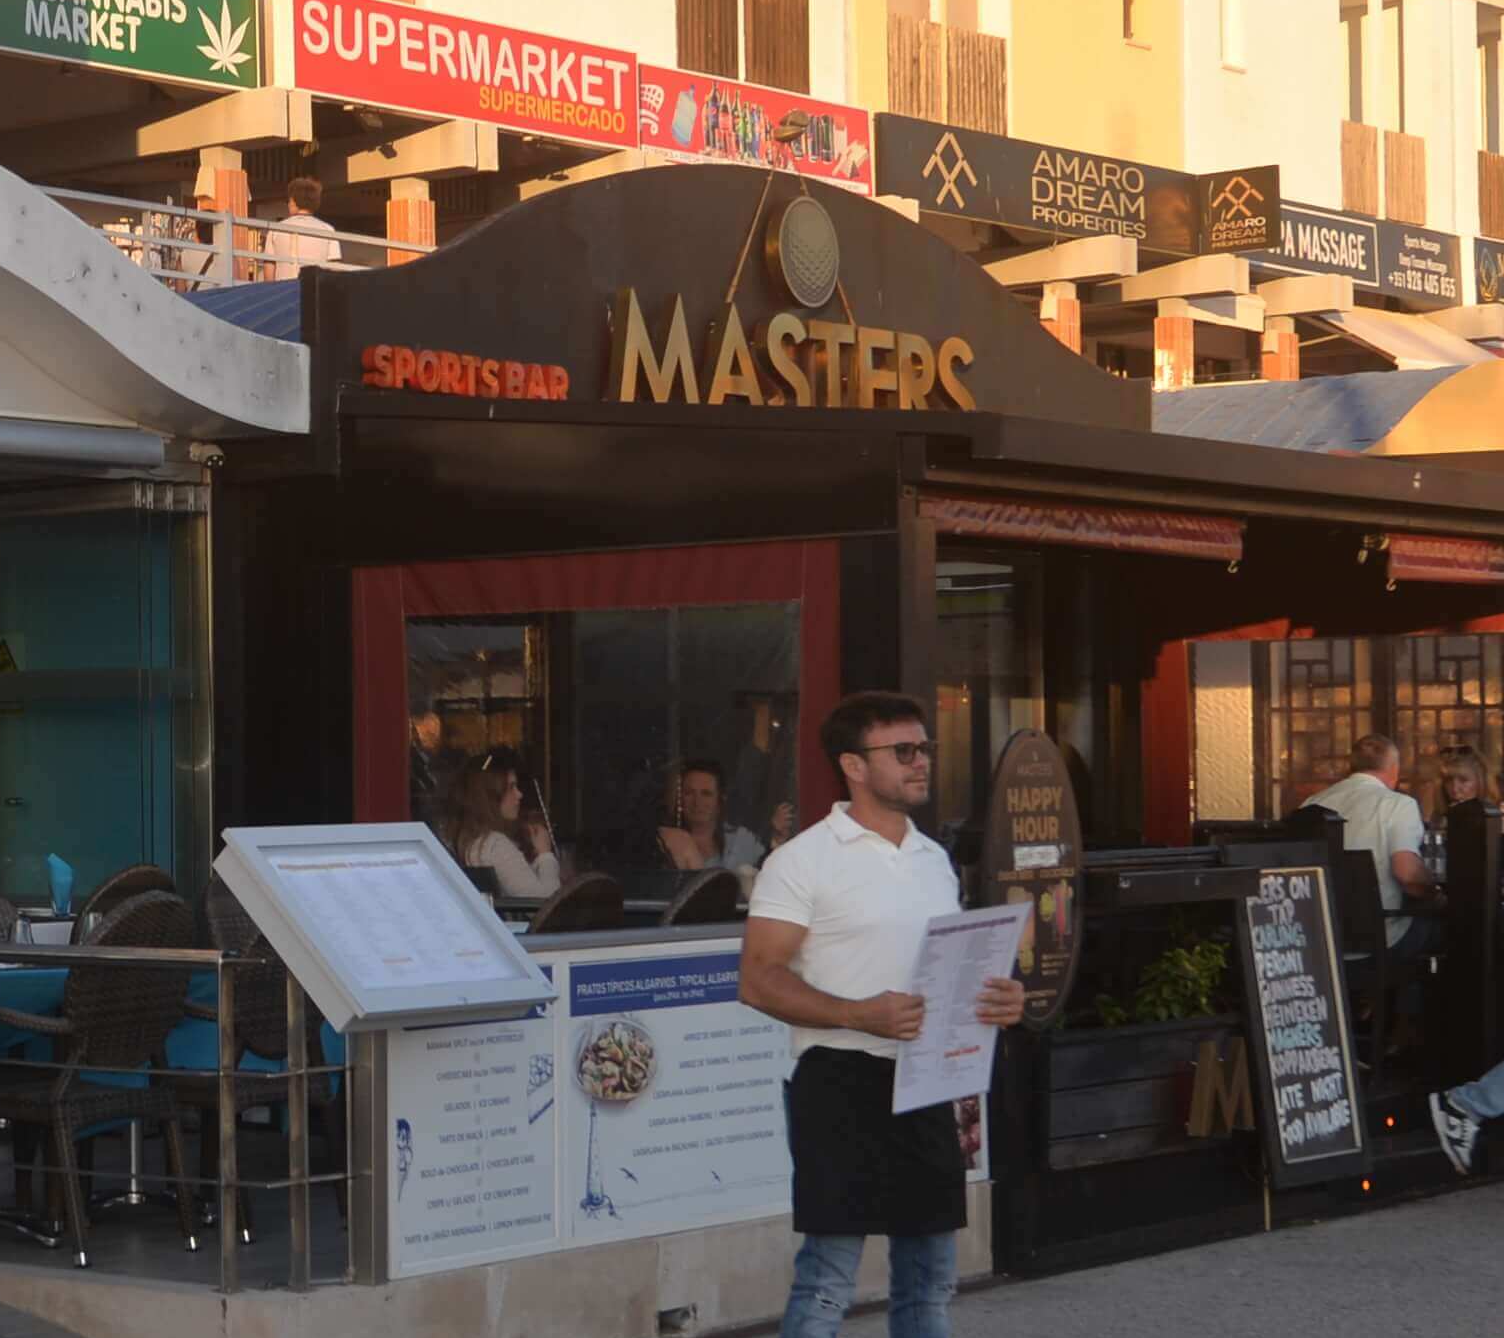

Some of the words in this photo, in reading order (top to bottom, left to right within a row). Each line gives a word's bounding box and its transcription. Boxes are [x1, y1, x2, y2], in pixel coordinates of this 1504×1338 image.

[302, 0, 629, 109] SUPERMARKET
[478, 85, 626, 135] SUPERMERCADO
[1032, 150, 1144, 194] AMARO
[1032, 176, 1145, 221] DREAM
[1032, 205, 1147, 240] PROPERTIES
[1211, 216, 1267, 232] AMARO
[1211, 227, 1267, 242] DREAM
[1297, 222, 1367, 271] MASSAGE
[619, 286, 976, 411] MASTERS
[363, 344, 497, 398] SPORTS
[497, 361, 569, 401] BAR
[1007, 787, 1063, 813] HAPPY
[1013, 815, 1060, 842] HOUR
